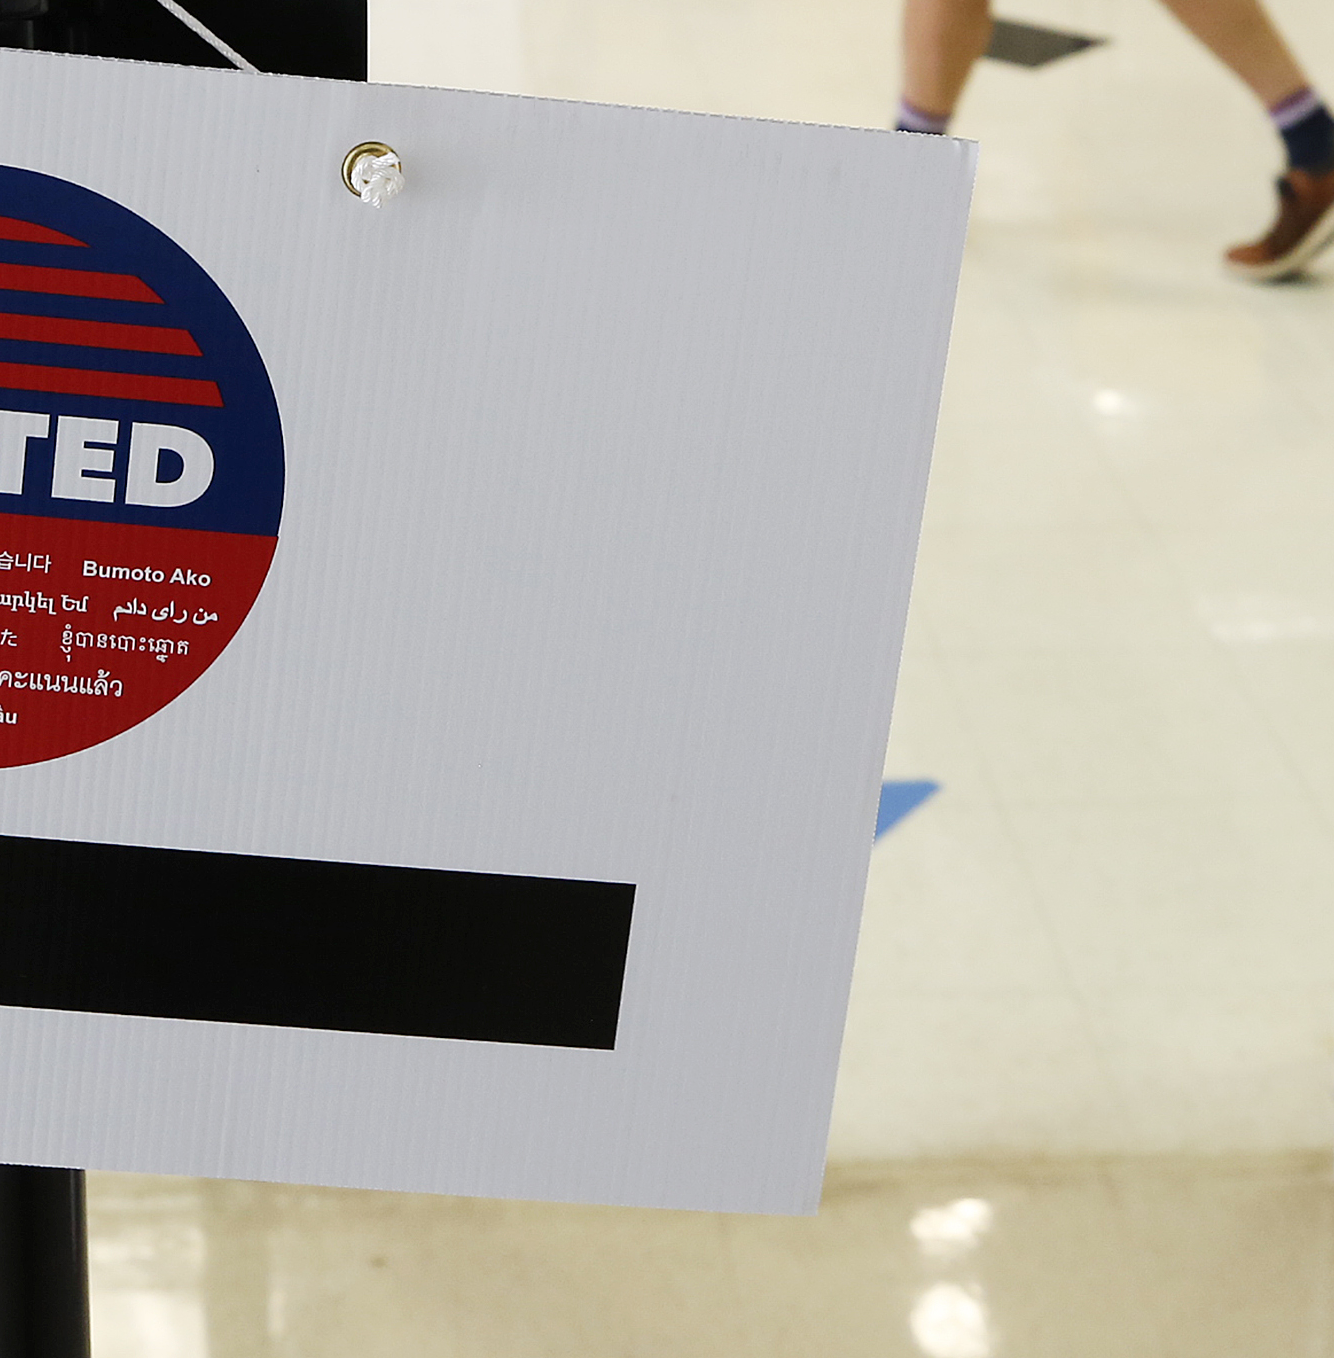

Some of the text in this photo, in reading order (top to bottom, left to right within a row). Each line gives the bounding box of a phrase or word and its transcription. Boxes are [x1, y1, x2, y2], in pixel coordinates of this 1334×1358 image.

[82, 559, 211, 587] Bumoto Ako
[60, 594, 90, 613] Եմ
